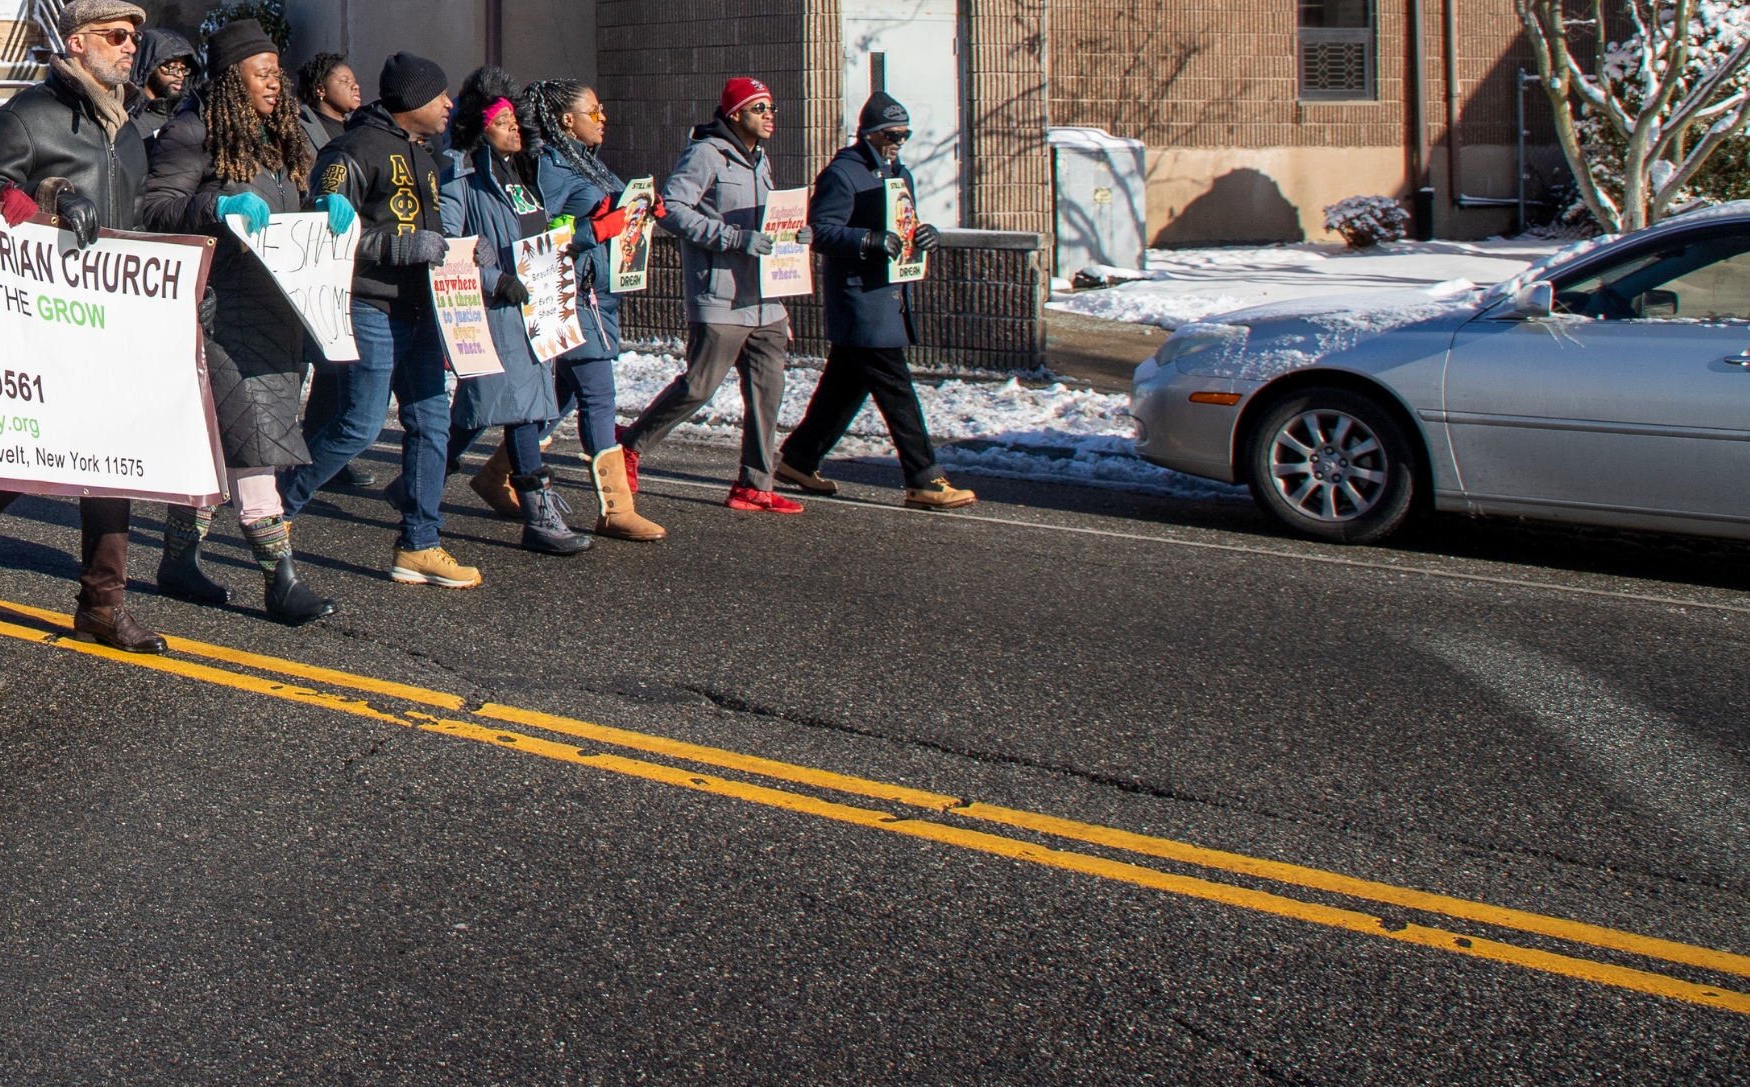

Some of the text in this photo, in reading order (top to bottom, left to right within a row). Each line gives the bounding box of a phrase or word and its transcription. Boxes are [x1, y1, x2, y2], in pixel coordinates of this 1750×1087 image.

[769, 205, 804, 221] Injustice
[765, 217, 804, 233] anywhere
[780, 230, 797, 242] thre
[774, 243, 804, 258] justice
[61, 248, 183, 300] CHURCH
[532, 264, 559, 282] Beautiful
[771, 268, 801, 281] where.
[899, 266, 921, 278] DREAM
[434, 276, 477, 294] anywhere
[620, 275, 641, 288] DREAM
[435, 292, 481, 308] is a threat
[538, 295, 554, 307] Every
[36, 294, 106, 329] GROW
[442, 307, 482, 327] to justice
[538, 306, 557, 320] Shade
[453, 325, 481, 341] every-
[456, 339, 485, 355] where.
[36, 447, 66, 469] New
[69, 451, 101, 473] York
[104, 455, 145, 478] 11575
